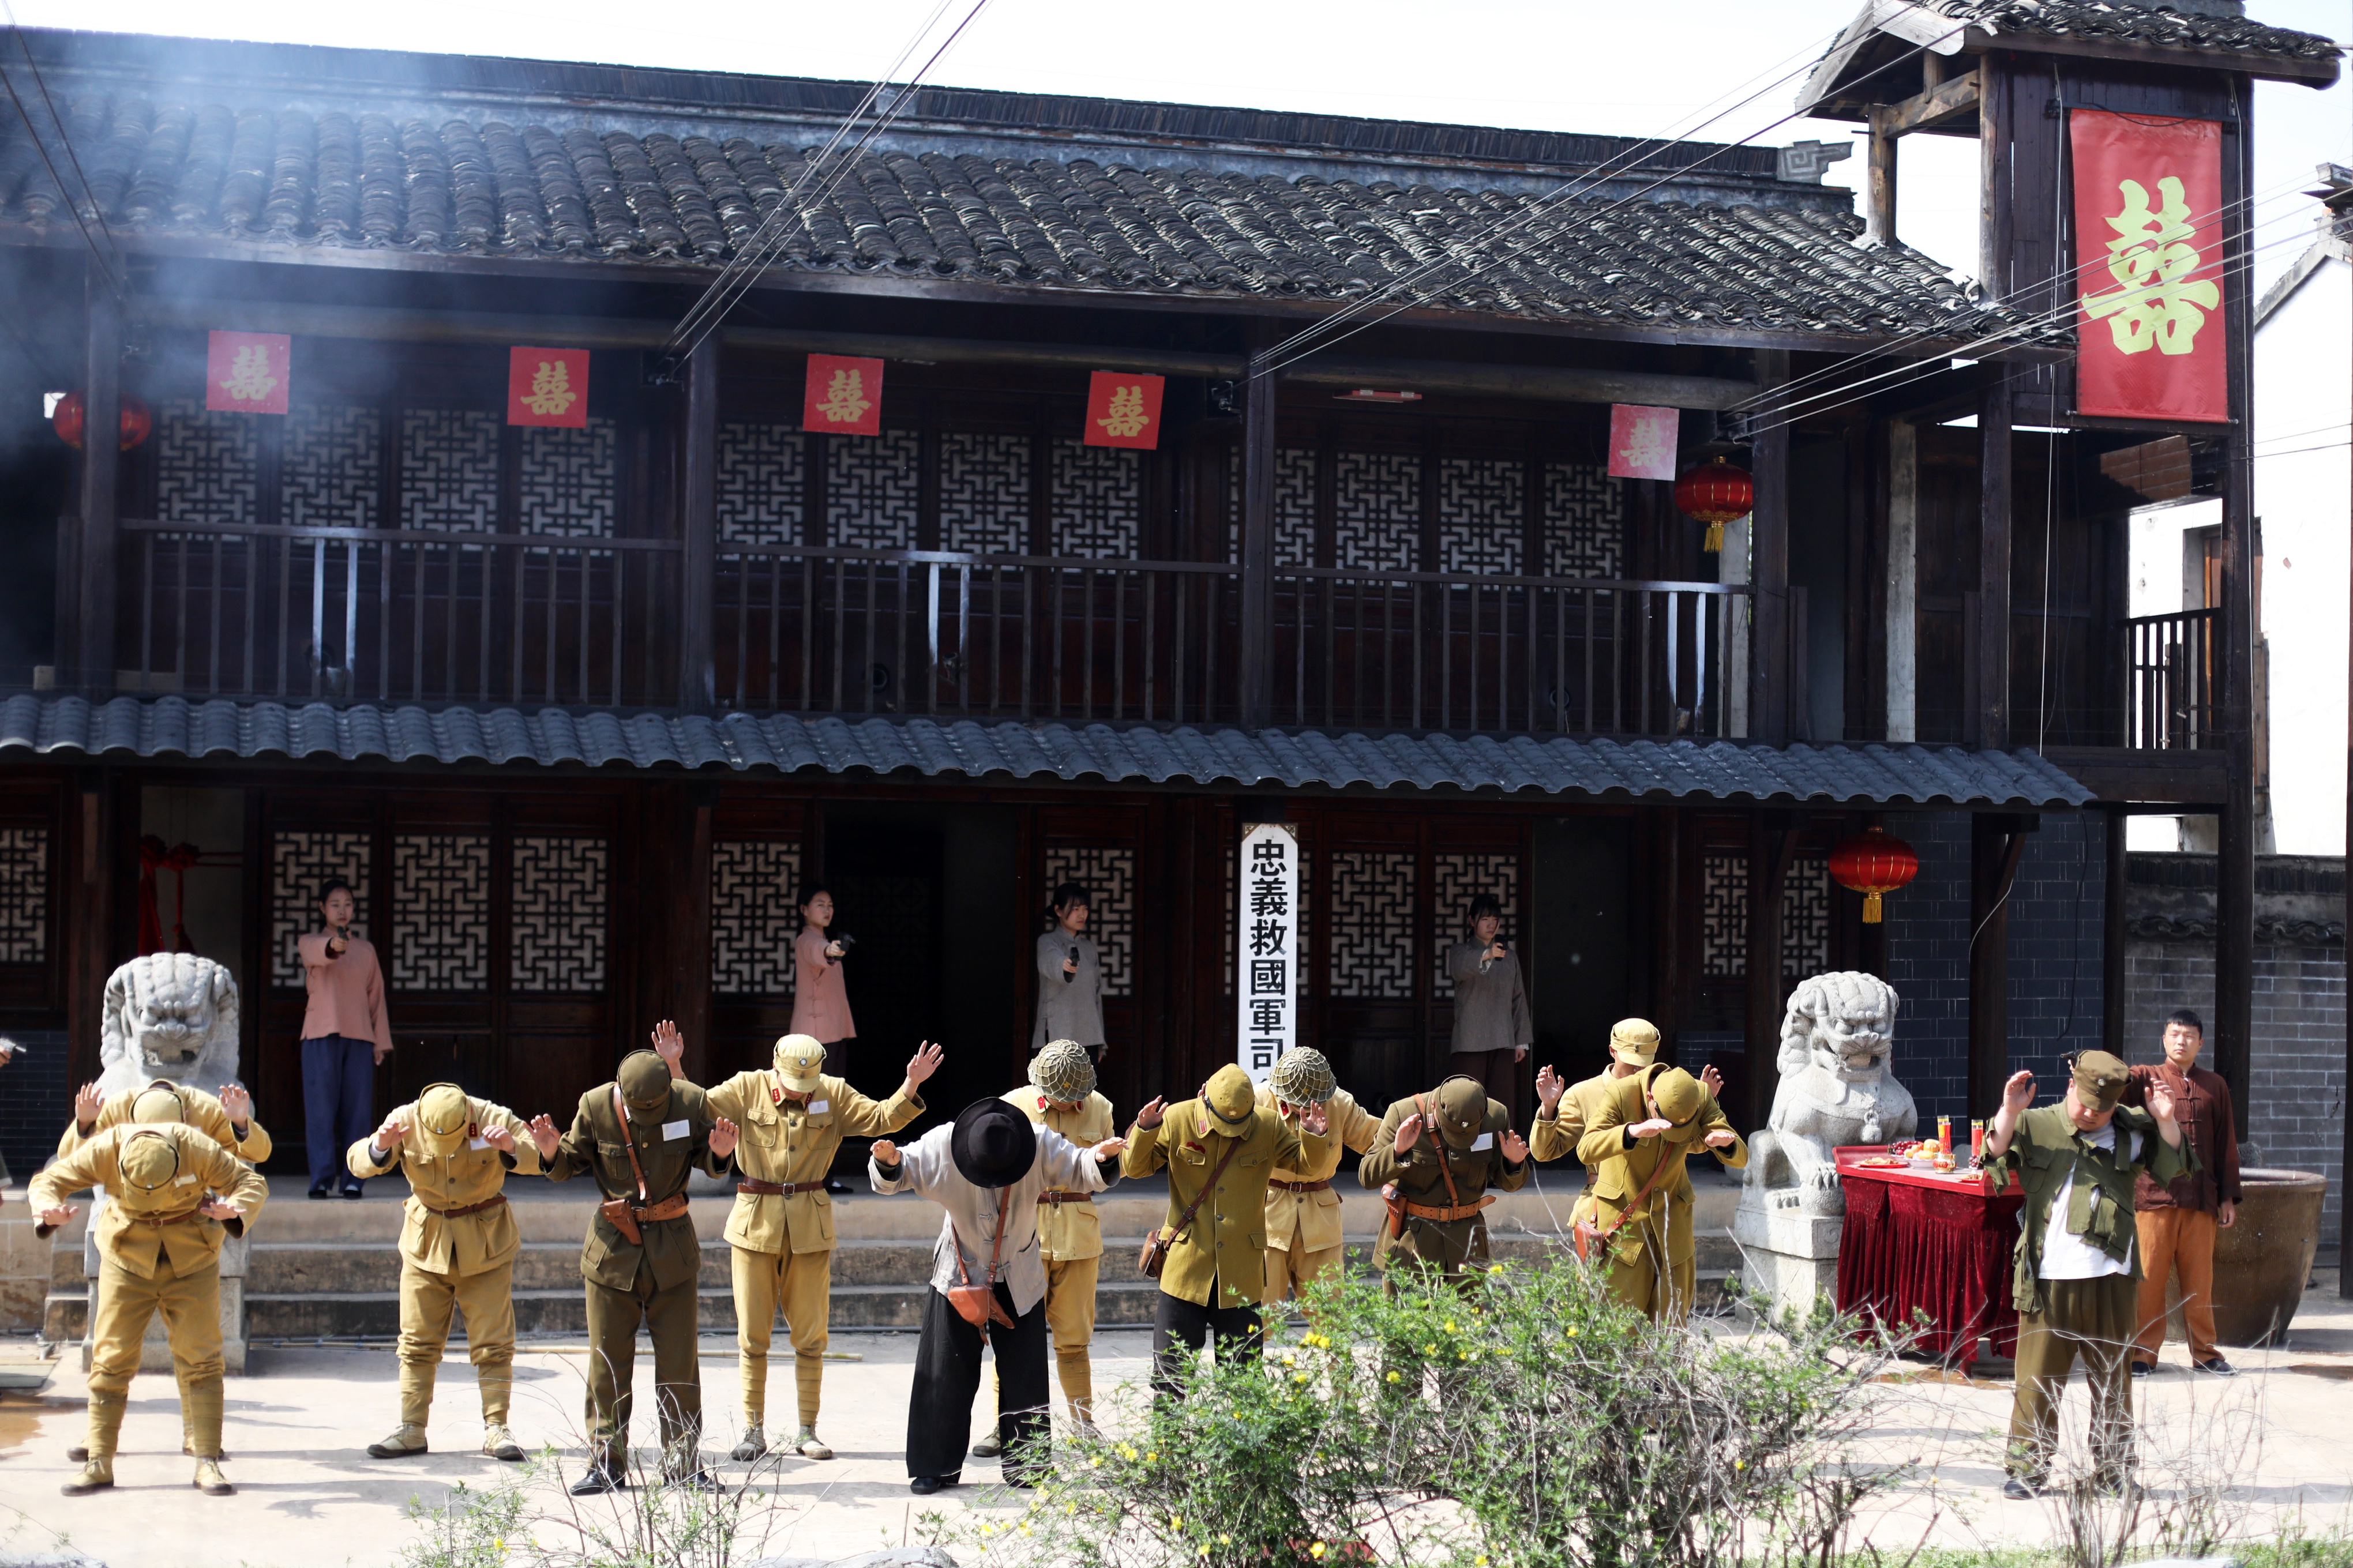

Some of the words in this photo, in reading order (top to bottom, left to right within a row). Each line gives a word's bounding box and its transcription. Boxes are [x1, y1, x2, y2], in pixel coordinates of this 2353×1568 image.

[2081, 176, 2220, 355] 囍
[220, 345, 277, 400] 囍
[520, 360, 576, 415] 囍
[816, 369, 872, 423] 囍
[1097, 386, 1150, 437] 囍
[1620, 417, 1667, 468] 囍
[1249, 838, 1288, 1084] 忠義救國軍司
